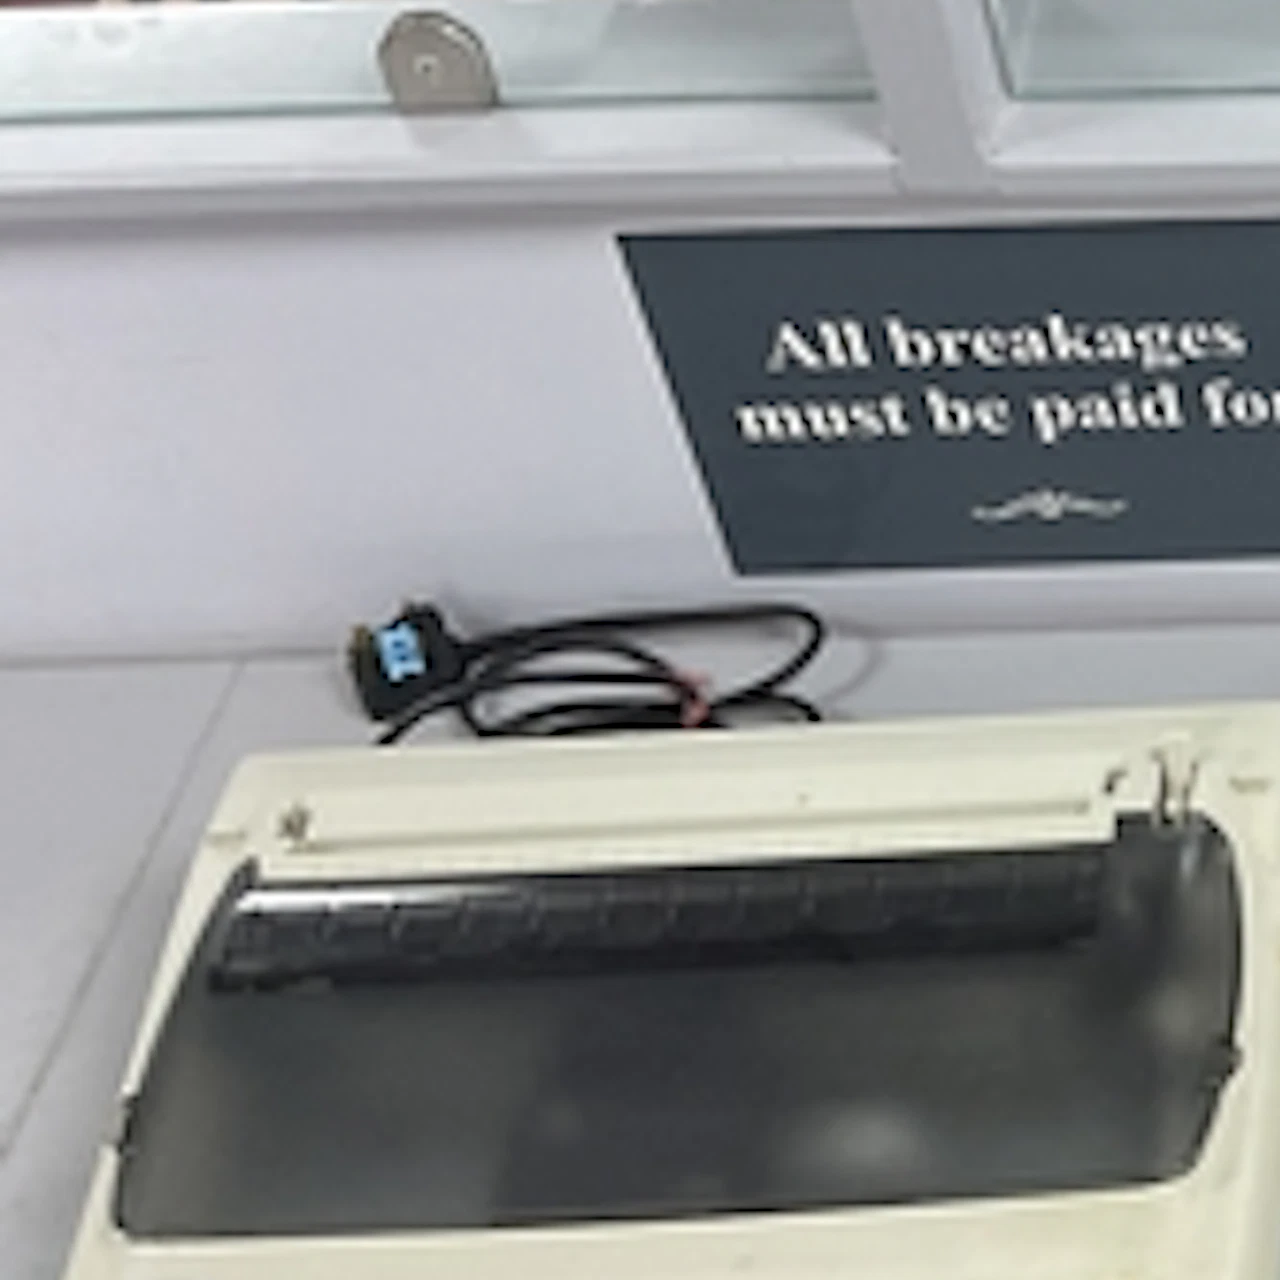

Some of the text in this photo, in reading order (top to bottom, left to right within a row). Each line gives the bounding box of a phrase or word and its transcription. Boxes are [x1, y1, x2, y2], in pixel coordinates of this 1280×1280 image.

[766, 315, 1247, 372] All breakages
[735, 389, 909, 443] must
[925, 386, 1011, 436] be
[1031, 380, 1184, 444] paid
